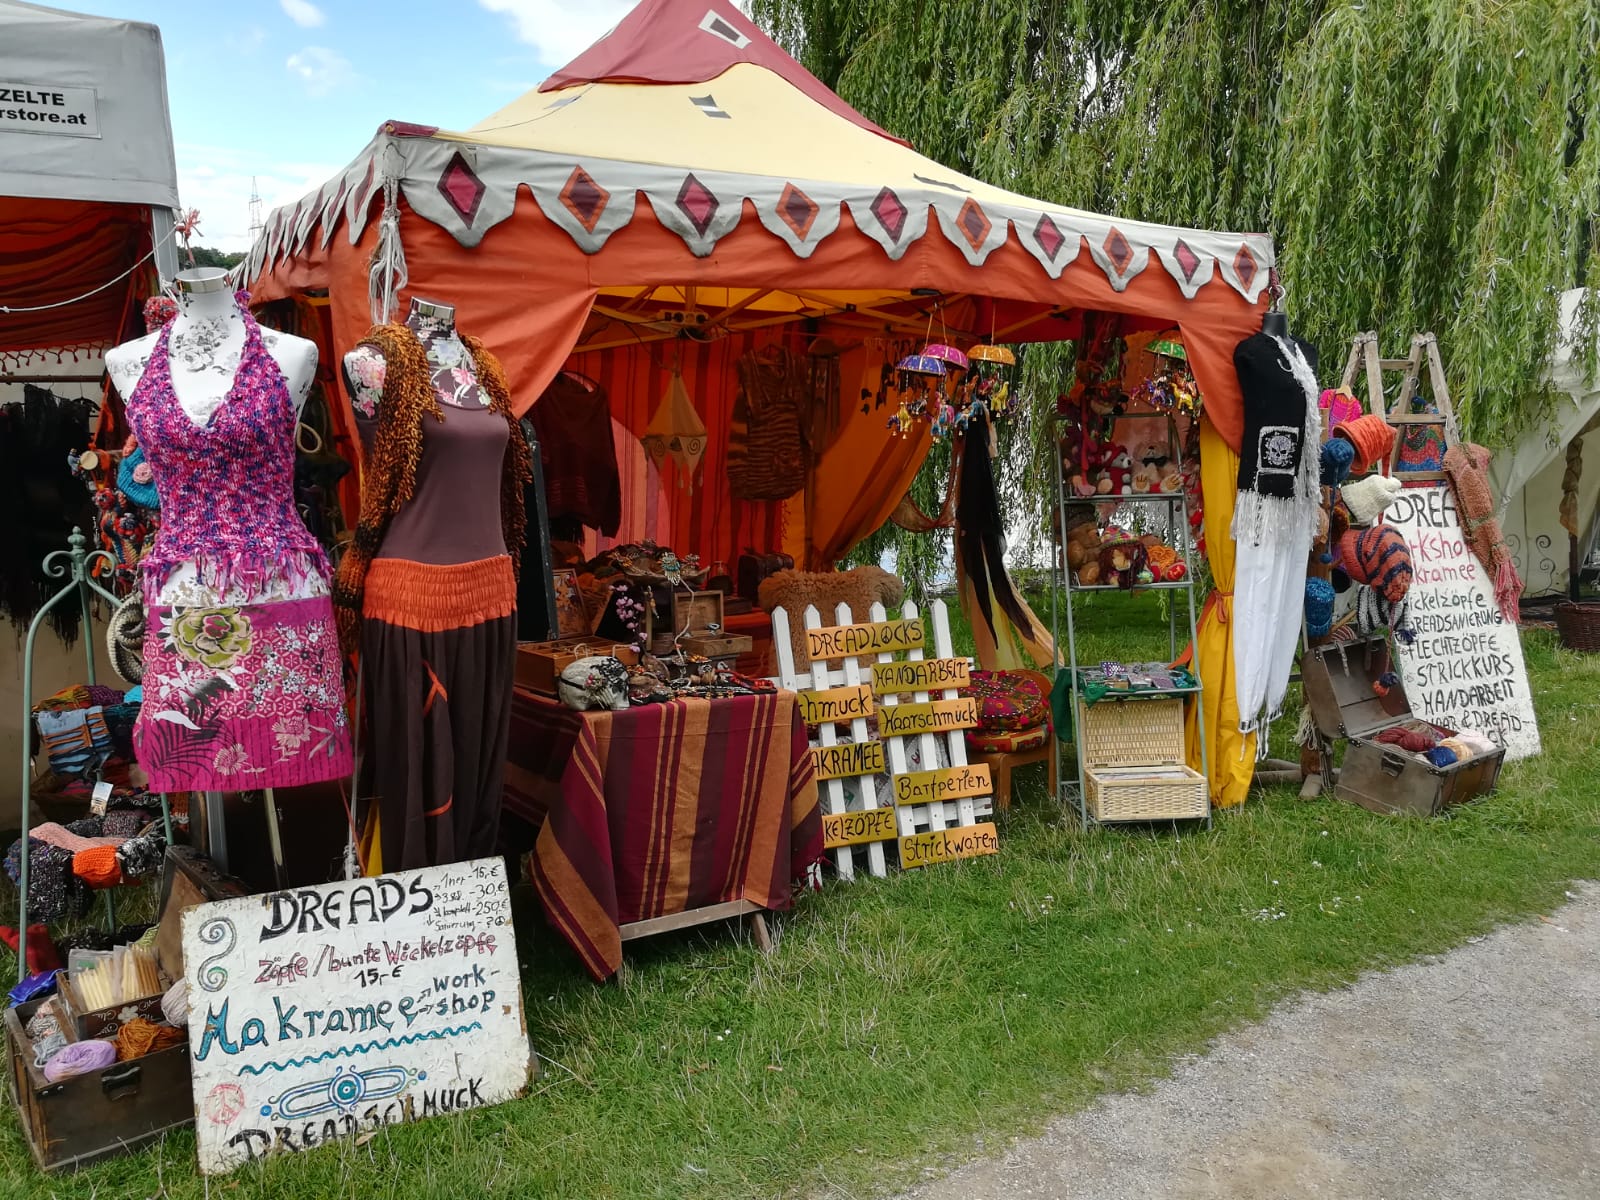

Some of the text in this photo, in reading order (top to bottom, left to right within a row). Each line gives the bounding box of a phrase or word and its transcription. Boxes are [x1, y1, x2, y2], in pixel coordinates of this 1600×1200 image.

[0, 88, 65, 106] ZELTE
[0, 107, 87, 125] rstore.at
[1410, 561, 1476, 586] kramee
[1408, 586, 1487, 611] ickelzöpfe
[808, 620, 923, 657] DREADLOCKS
[873, 660, 967, 689] HANDARBEIT
[1416, 654, 1514, 687] STRICKKURS
[1421, 678, 1516, 715] HANDARBEIT
[881, 702, 978, 734] Haarschmuck
[899, 769, 991, 800] Bartperlen
[904, 831, 999, 862] Strickwaren
[259, 874, 434, 943] DREADS
[254, 951, 308, 986] Zöpfe
[382, 932, 498, 966] Wickelzöpfe
[435, 989, 497, 1016] shop
[194, 995, 419, 1062] Makramee
